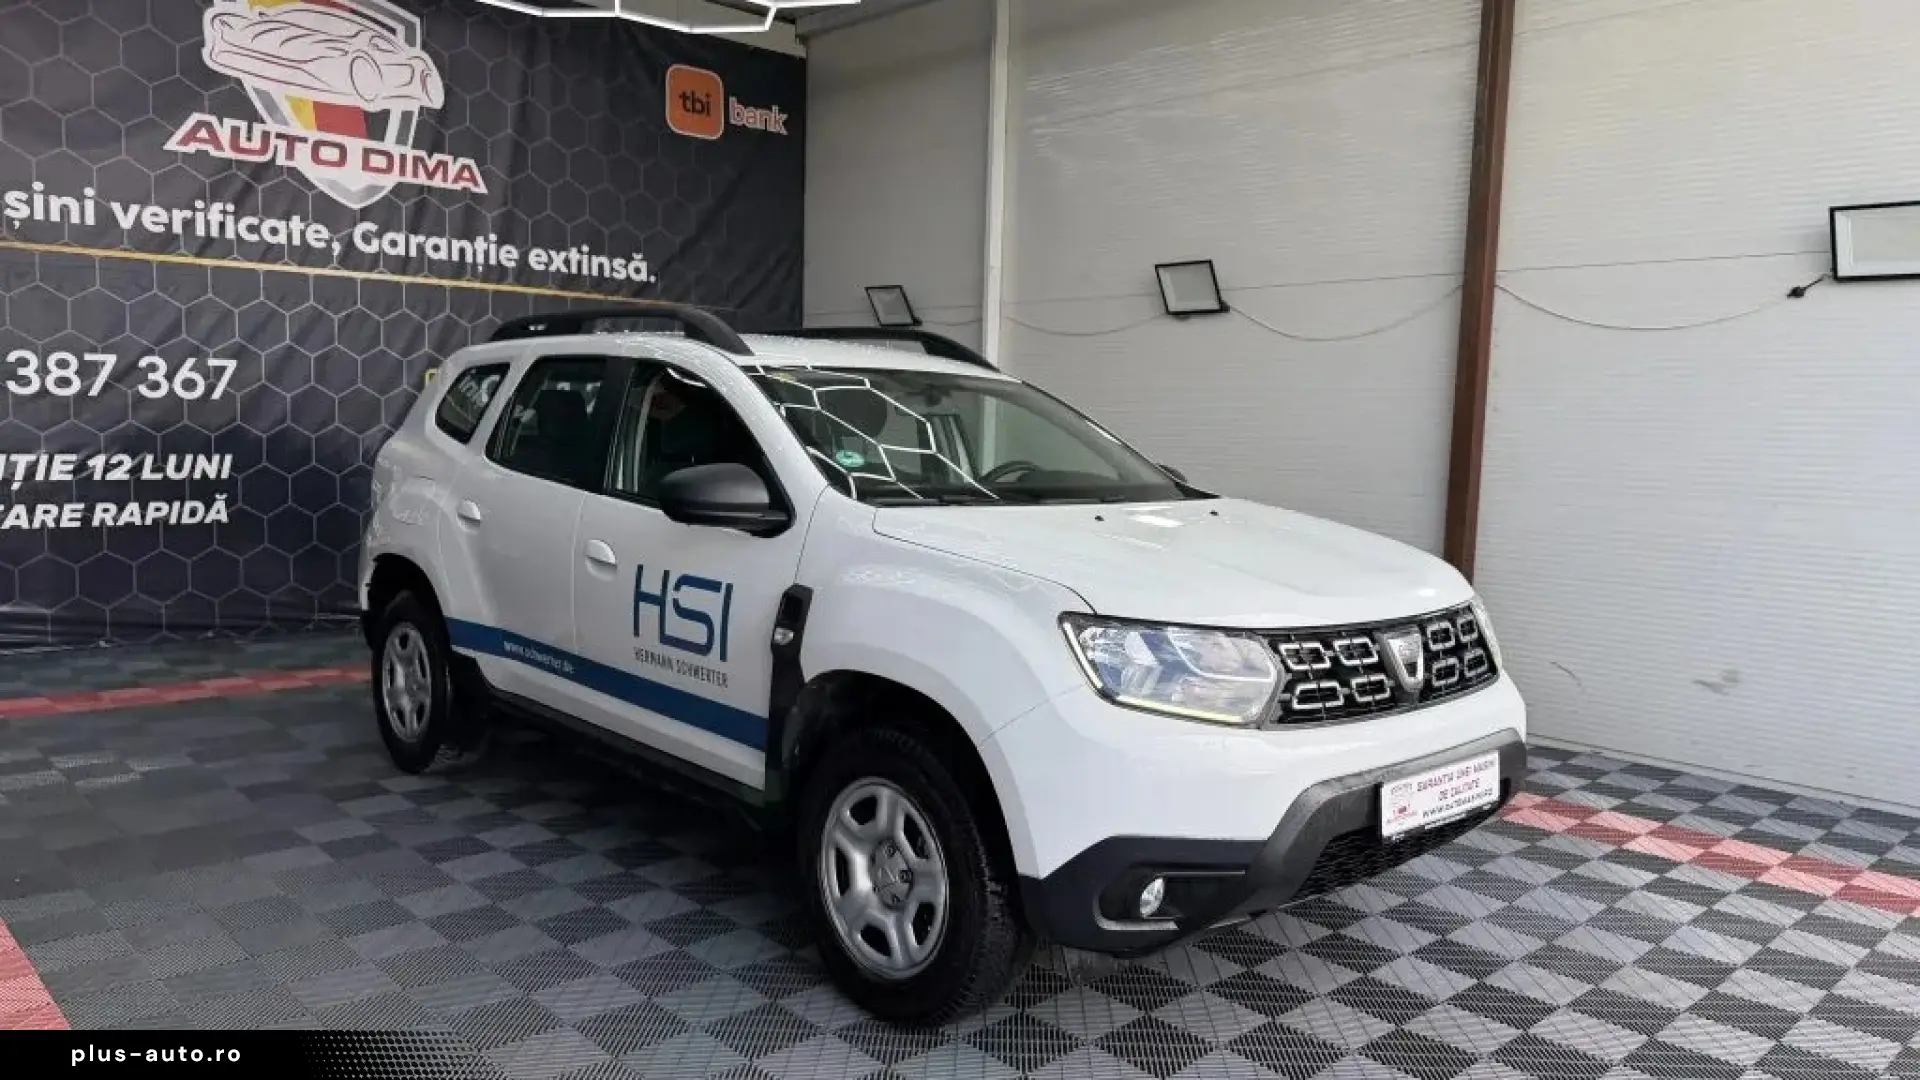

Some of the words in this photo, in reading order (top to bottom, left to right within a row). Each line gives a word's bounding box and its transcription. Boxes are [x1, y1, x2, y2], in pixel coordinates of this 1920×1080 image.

[679, 90, 712, 116] tbi
[729, 96, 788, 135] bank
[175, 118, 348, 168] AUTO
[361, 146, 480, 188] DIMA
[110, 199, 341, 256] verificate,
[352, 220, 520, 273] Garanție
[528, 244, 658, 284] extinsă.
[5, 349, 117, 396] 387
[138, 355, 238, 400] 367
[87, 453, 131, 481] 12
[140, 453, 233, 481] LUNI
[0, 502, 85, 530] ARE
[91, 493, 230, 528] RAPIDĂ
[633, 563, 734, 663] HSI
[633, 646, 674, 674] HERMANN
[676, 658, 729, 689] SCHWERTER
